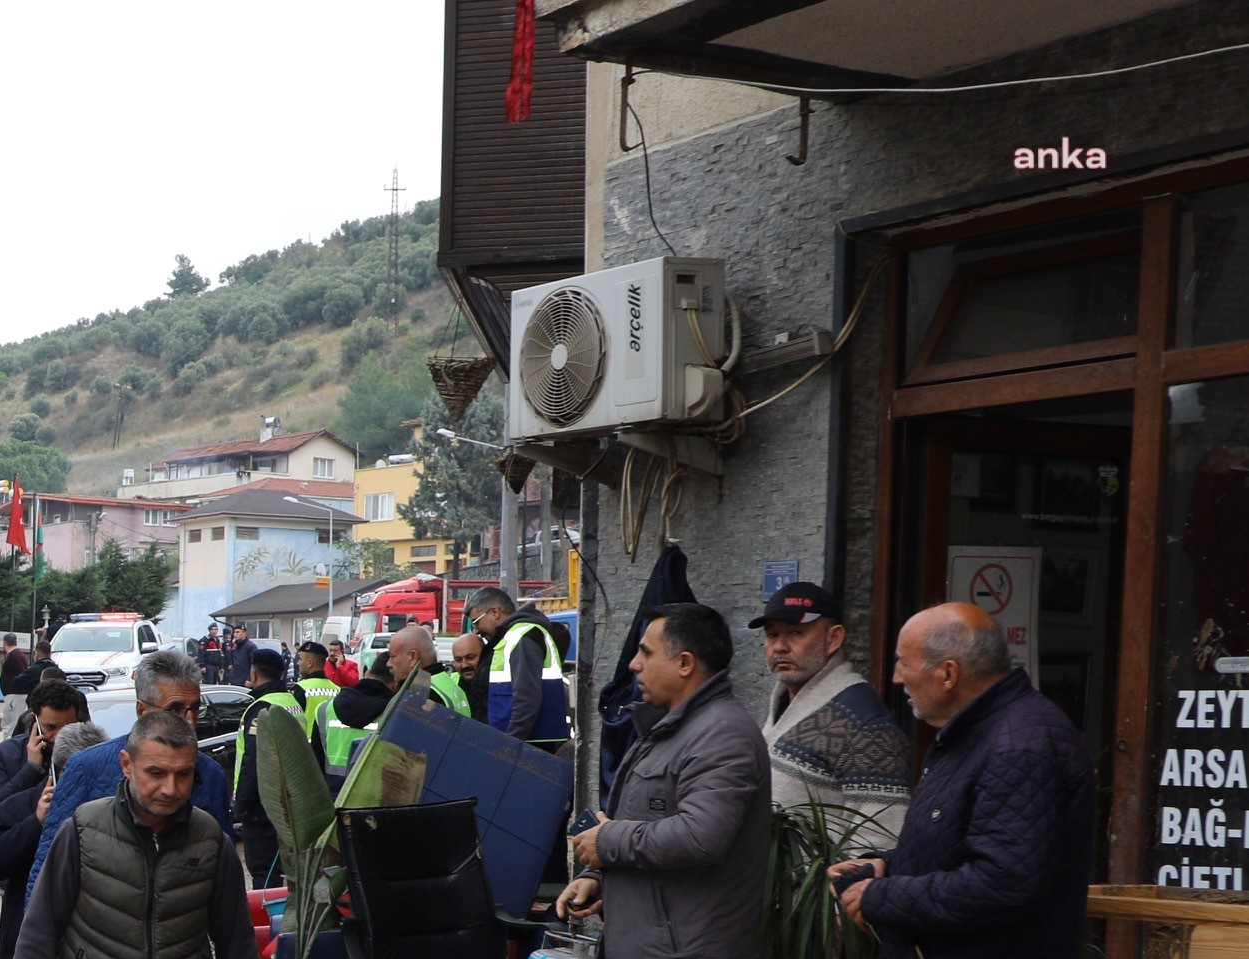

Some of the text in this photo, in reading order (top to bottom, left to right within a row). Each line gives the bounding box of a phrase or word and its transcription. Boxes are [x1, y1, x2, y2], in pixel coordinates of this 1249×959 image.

[629, 283, 644, 352] arçelik
[1007, 627, 1027, 645] MEZ
[1159, 748, 1249, 789] ARSA
[1160, 799, 1249, 849] BAĞ-
